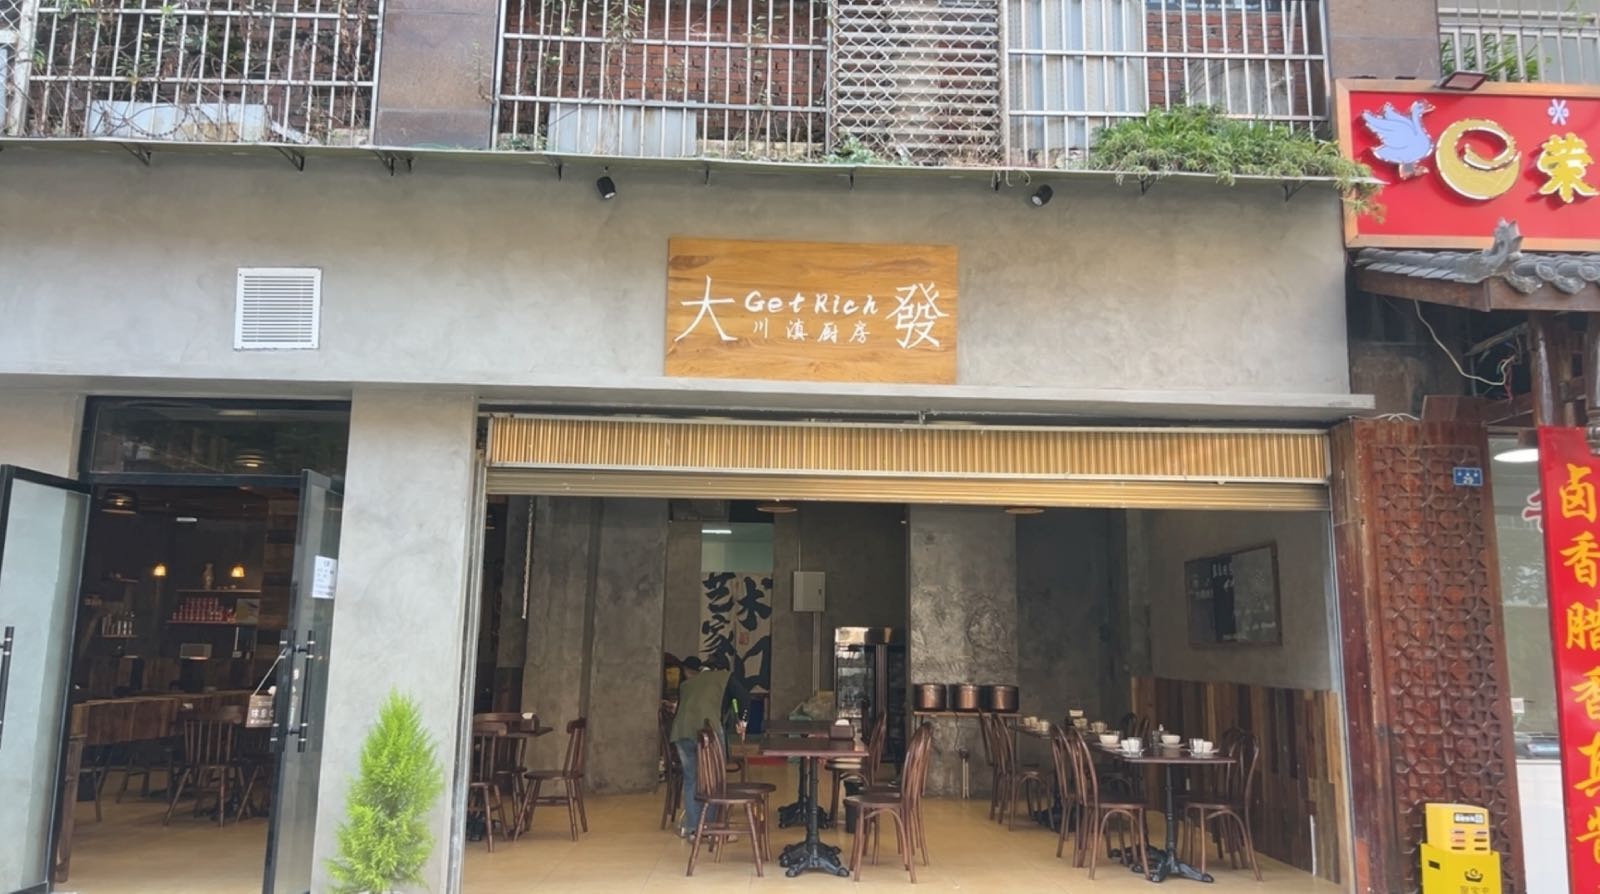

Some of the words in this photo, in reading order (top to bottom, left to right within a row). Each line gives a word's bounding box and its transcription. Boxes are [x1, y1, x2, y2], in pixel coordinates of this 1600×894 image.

[674, 275, 738, 342] 大
[744, 290, 805, 313] Get
[814, 293, 879, 315] Rich
[886, 282, 949, 349] 發
[753, 318, 871, 343] 川滇厨房
